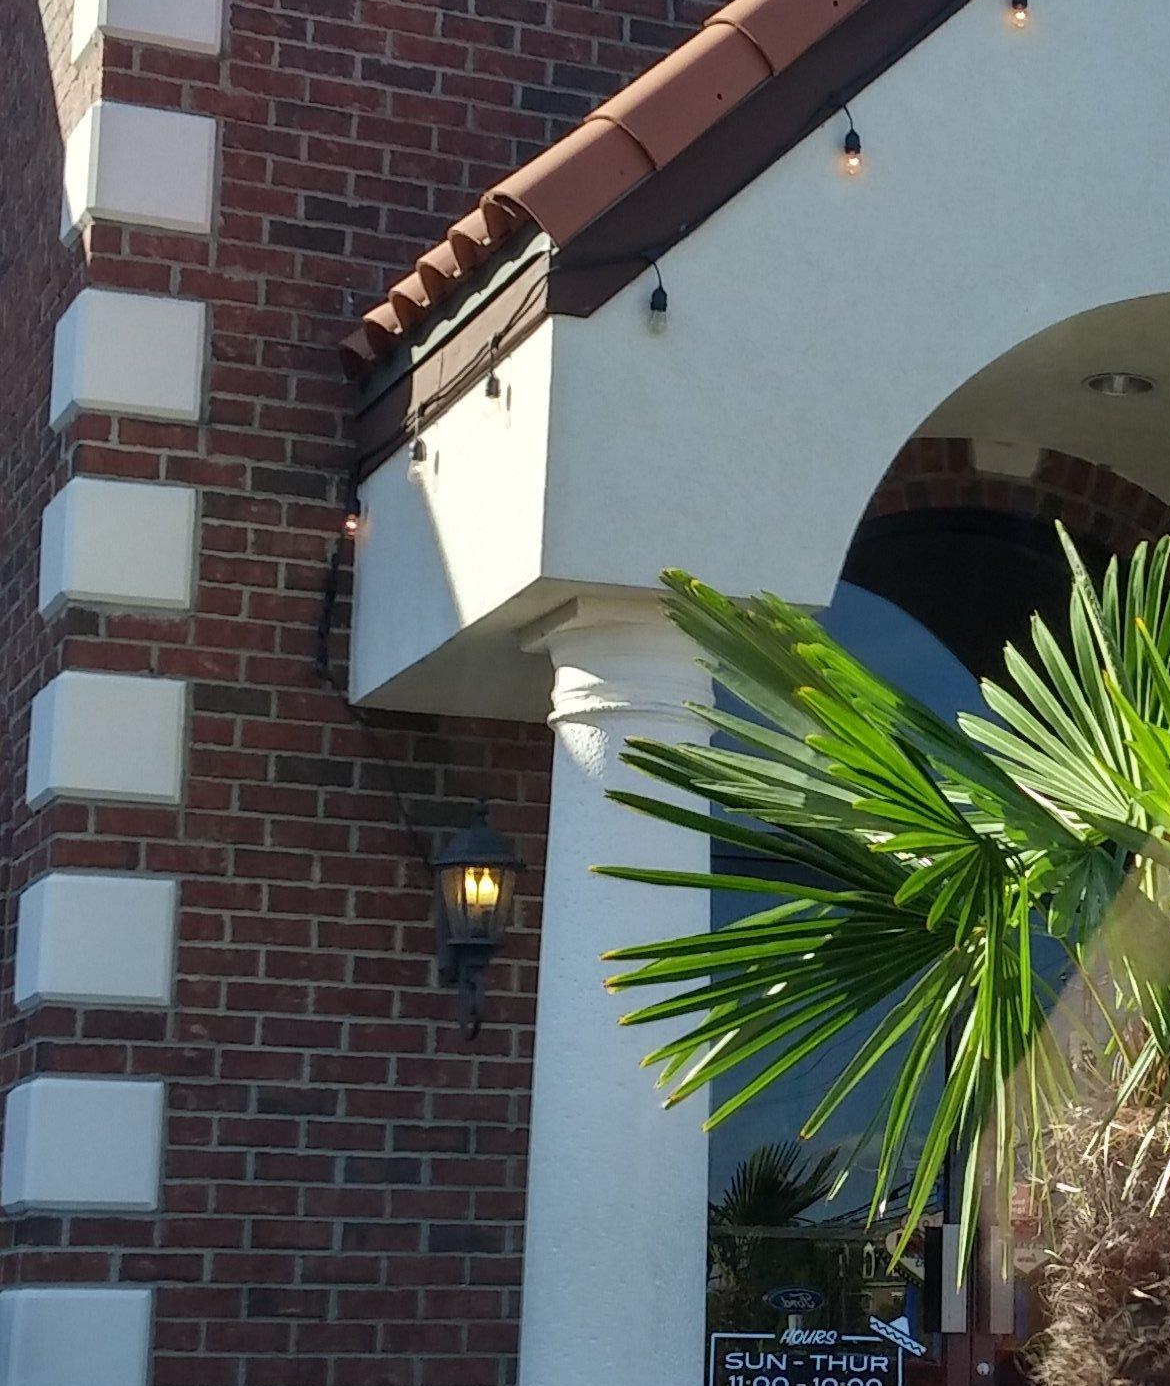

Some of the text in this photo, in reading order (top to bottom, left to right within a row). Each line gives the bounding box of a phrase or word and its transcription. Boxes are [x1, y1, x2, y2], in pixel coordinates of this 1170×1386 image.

[779, 1328, 838, 1346] HOURS
[724, 1352, 788, 1371] SUN
[809, 1354, 889, 1373] THUR
